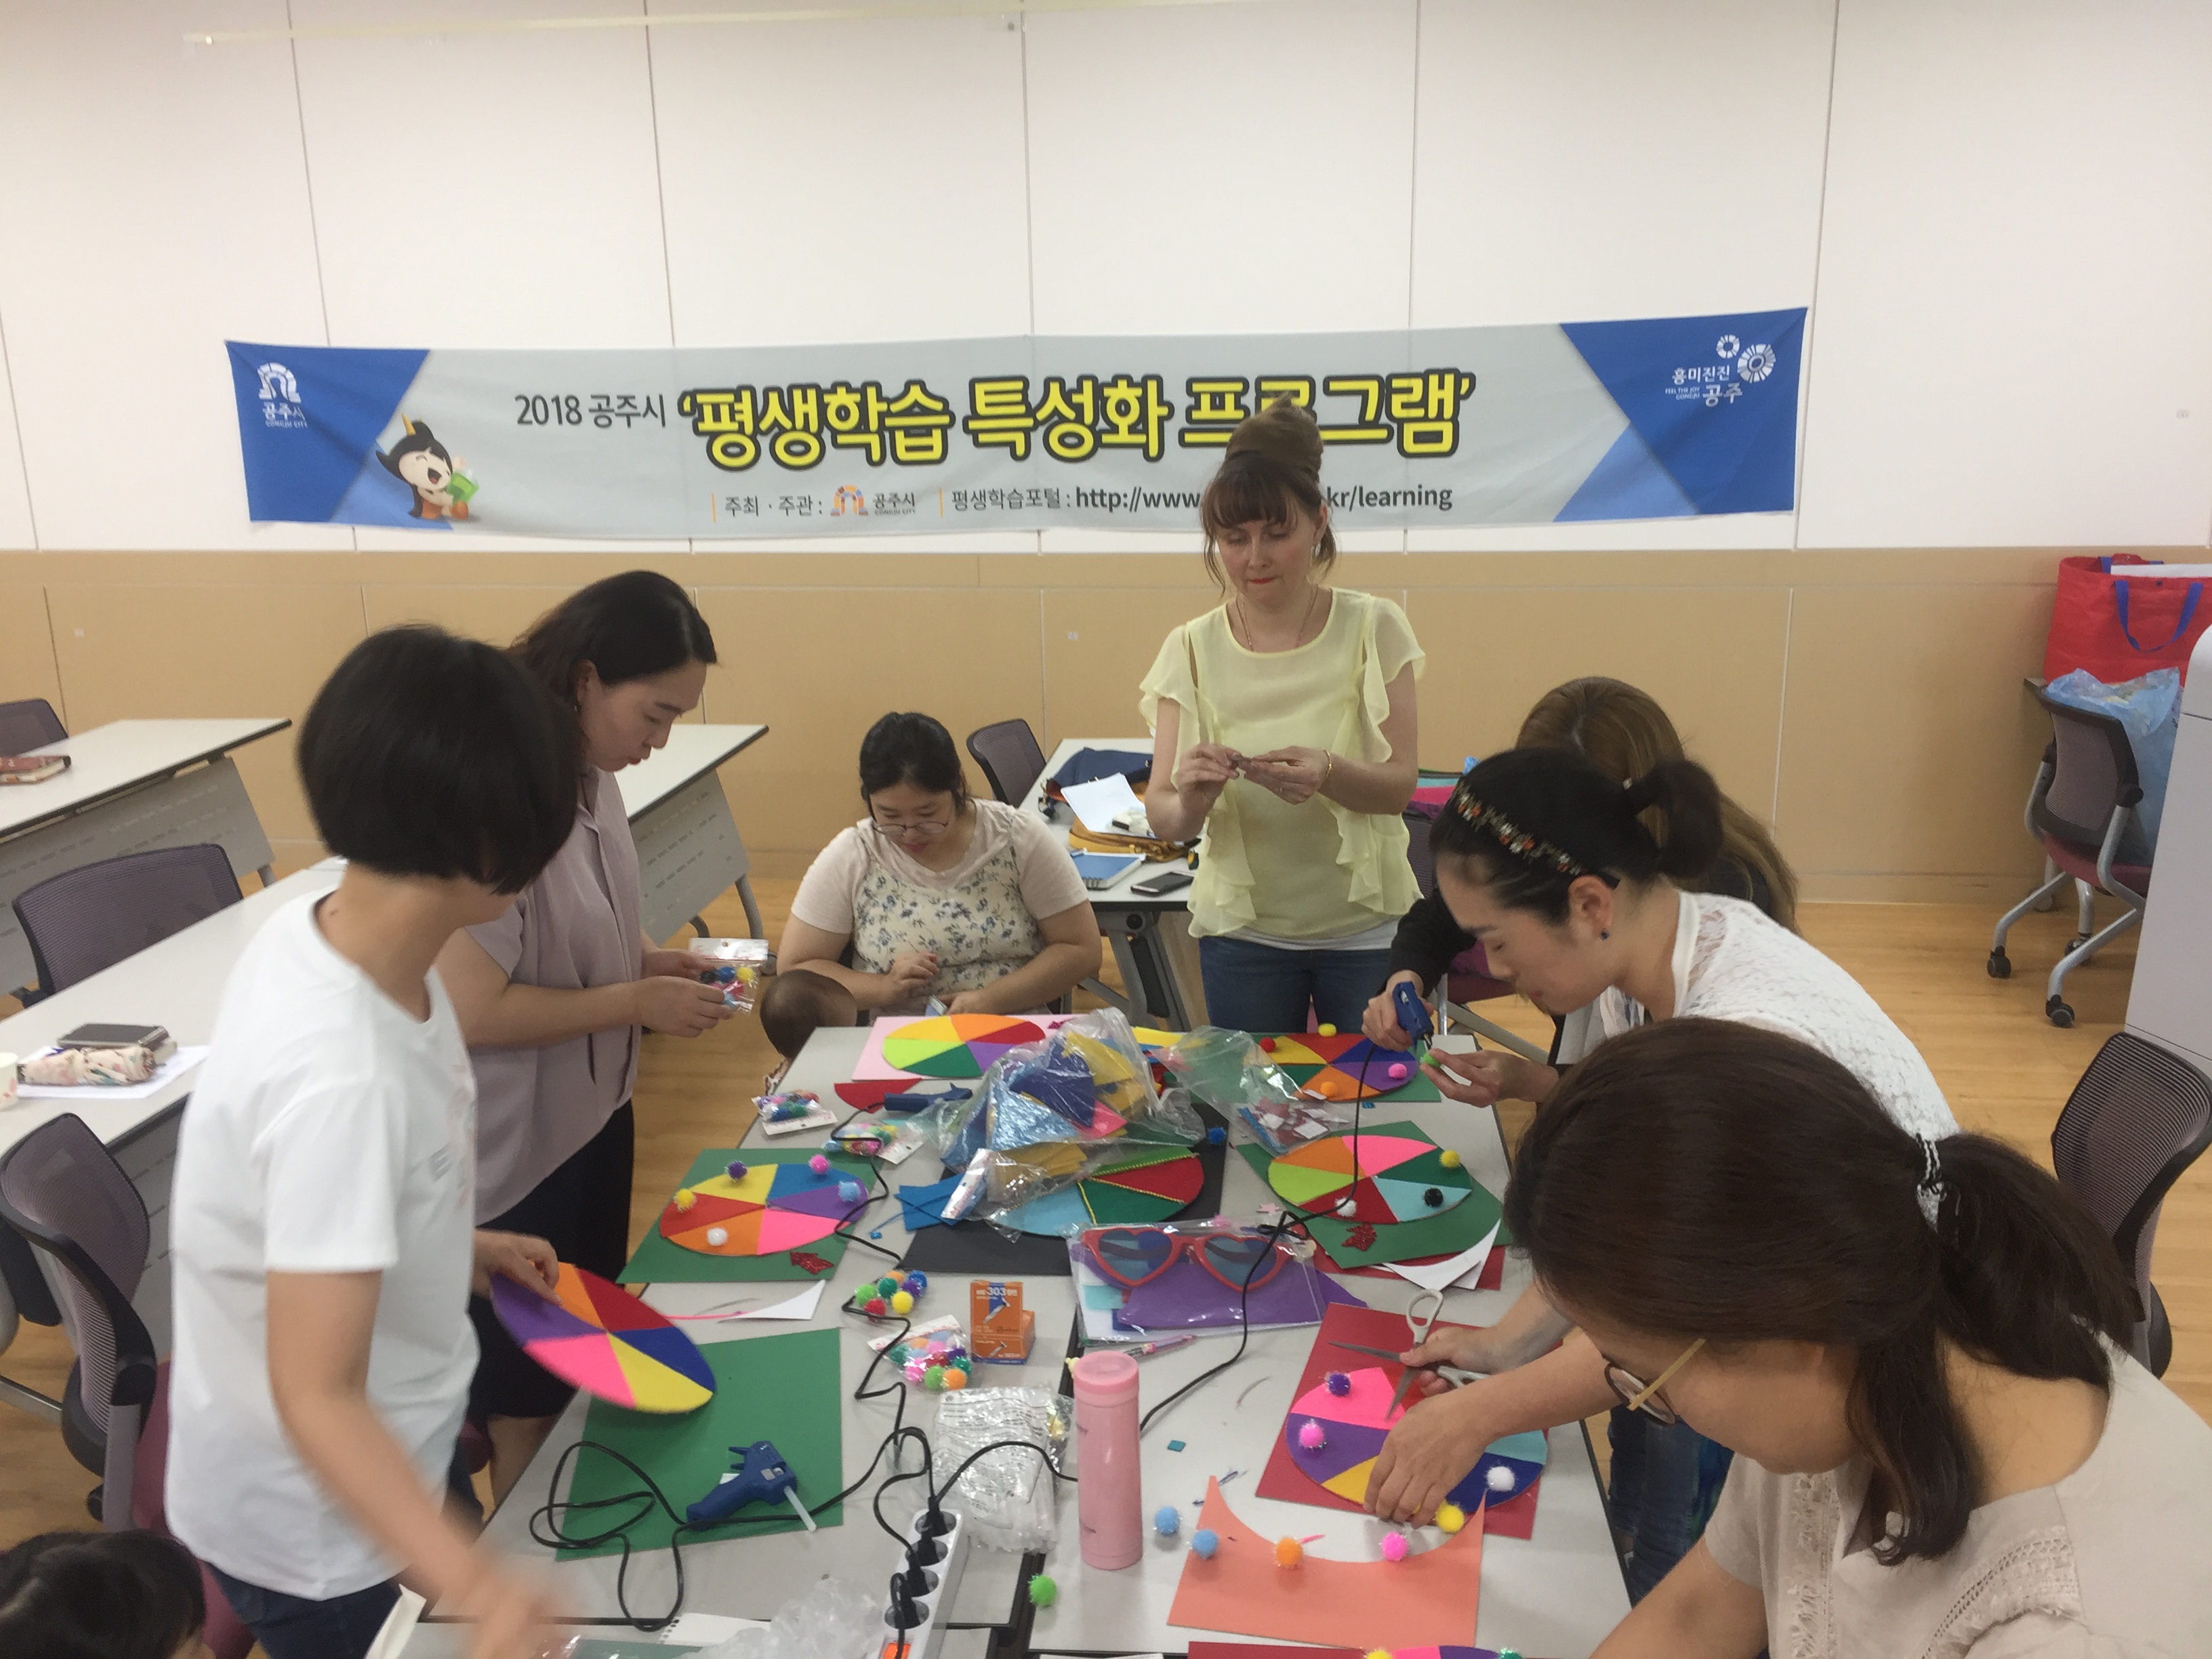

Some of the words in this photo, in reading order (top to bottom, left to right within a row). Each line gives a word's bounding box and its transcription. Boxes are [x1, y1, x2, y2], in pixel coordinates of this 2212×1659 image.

[1672, 365, 1729, 385] 흥미진진
[1702, 382, 1742, 407] 공주
[262, 402, 306, 422] 공주시
[515, 394, 583, 426] 2018
[588, 393, 666, 429] 공주시
[962, 373, 1174, 464] 특성화
[724, 495, 758, 517] 주최
[779, 495, 813, 516] 주관
[873, 491, 916, 509] 공주시
[951, 487, 1060, 512] 평생학습포털
[988, 1287, 1006, 1296] 303
